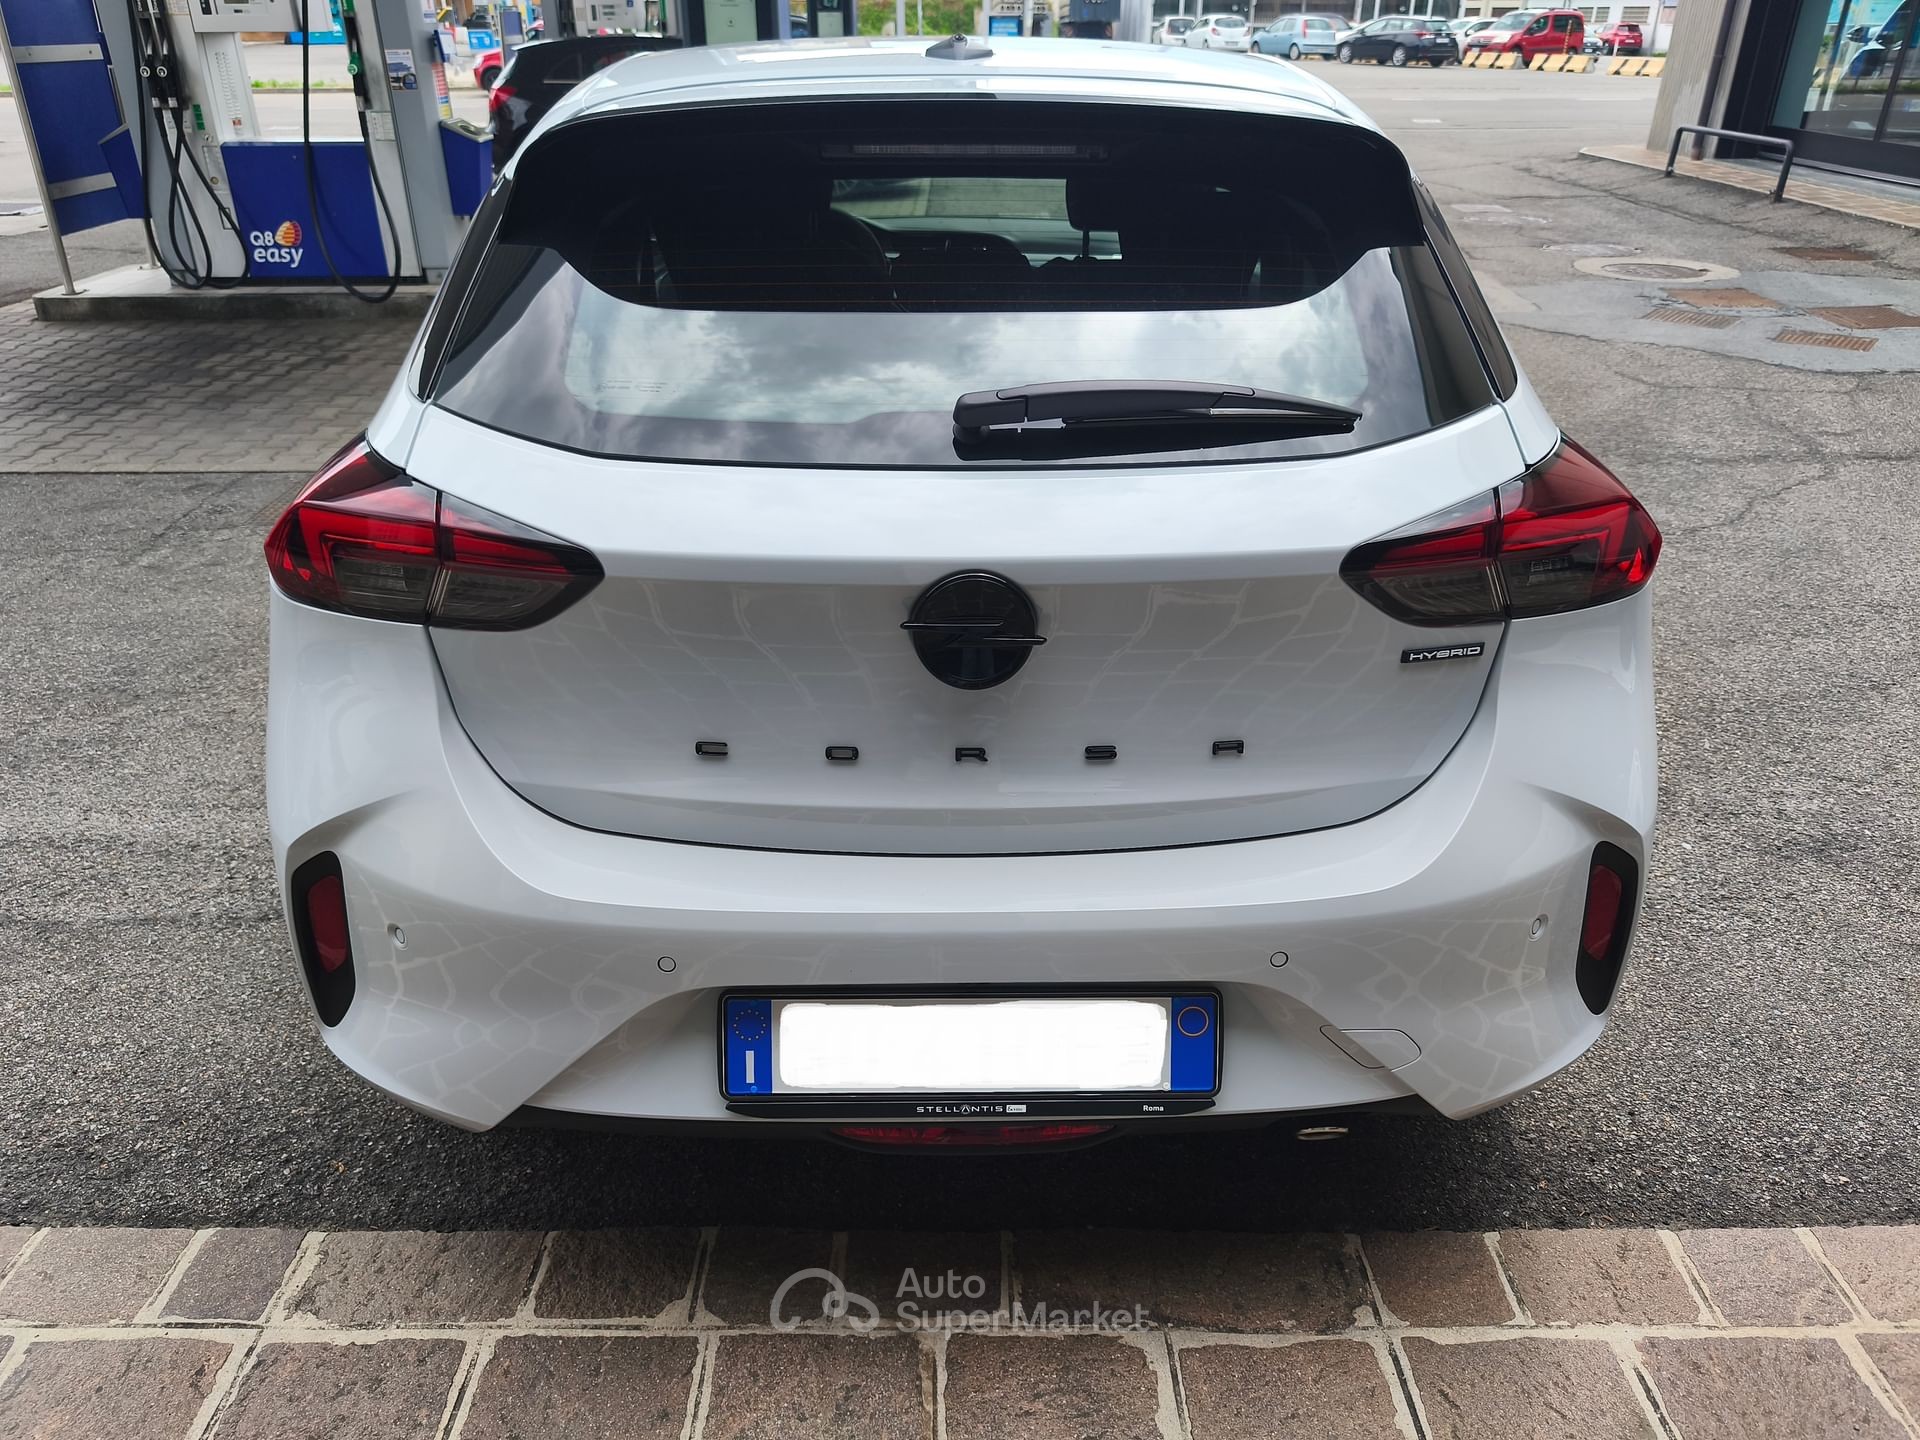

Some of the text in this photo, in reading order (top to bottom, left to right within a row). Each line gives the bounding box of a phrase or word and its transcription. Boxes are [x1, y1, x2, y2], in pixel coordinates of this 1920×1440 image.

[250, 231, 274, 246] Q8
[253, 248, 304, 268] easy
[1409, 647, 1481, 661] HYBRID
[695, 740, 1245, 762] CORSA
[916, 1104, 1003, 1115] STELLANTIS
[1142, 1104, 1165, 1112] Roma
